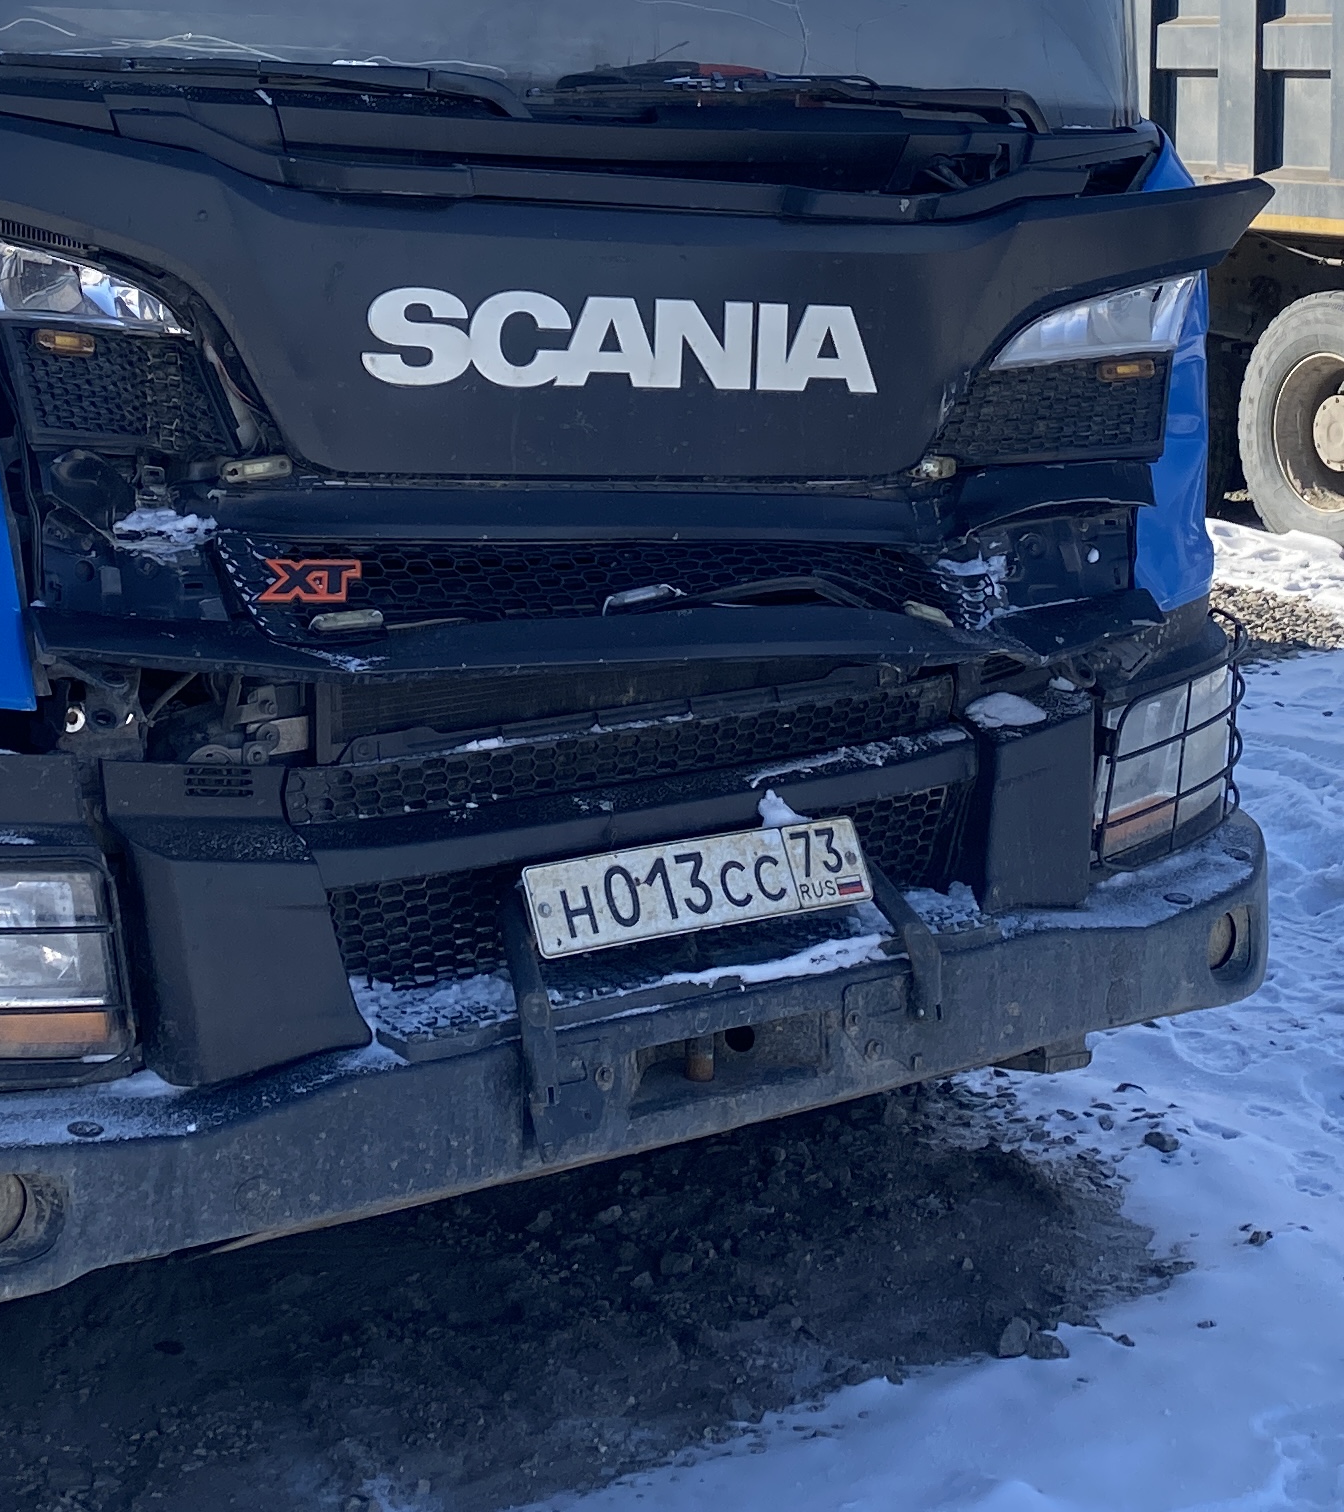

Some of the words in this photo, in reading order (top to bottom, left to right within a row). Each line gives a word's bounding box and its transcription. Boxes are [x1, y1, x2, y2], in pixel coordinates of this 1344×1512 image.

[361, 287, 878, 393] SCANIA
[259, 558, 362, 603] XT
[560, 851, 787, 939] Н013СС
[789, 828, 843, 878] 73
[799, 879, 836, 901] RUS
